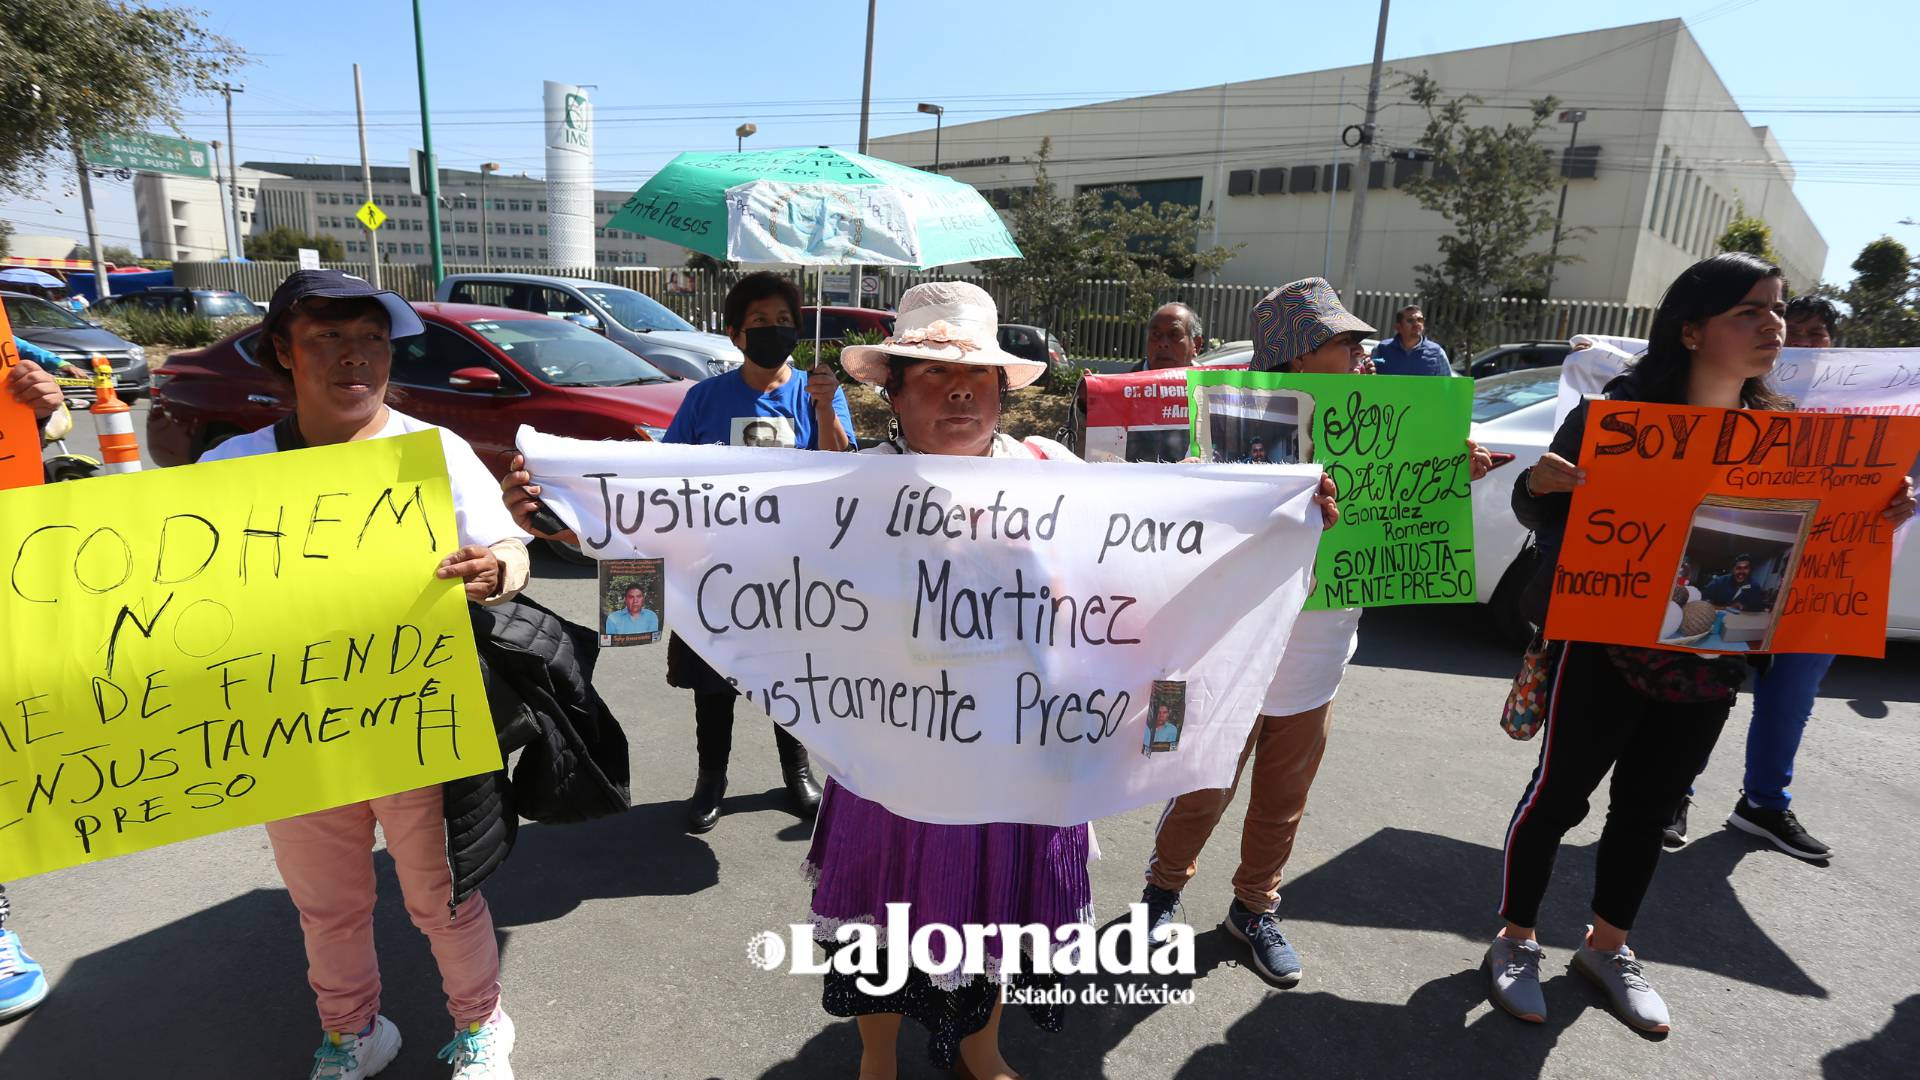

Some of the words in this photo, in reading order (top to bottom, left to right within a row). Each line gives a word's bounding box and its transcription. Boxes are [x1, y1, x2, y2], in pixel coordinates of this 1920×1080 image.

[1712, 409, 1897, 468] DANIEL
[1343, 503, 1423, 526] Gonzalez
[1726, 467, 1817, 490] Gonzalez
[1819, 467, 1882, 491] Romero
[12, 482, 436, 602] CODHEM
[582, 472, 780, 549] Justicia
[829, 496, 859, 549] y
[1098, 512, 1204, 563] para
[1383, 519, 1450, 541] Romero
[697, 556, 869, 633] Carlos
[1555, 560, 1651, 599] inocente
[96, 592, 234, 679] NO
[1015, 671, 1131, 746] Preso
[74, 773, 256, 854] PRESO
